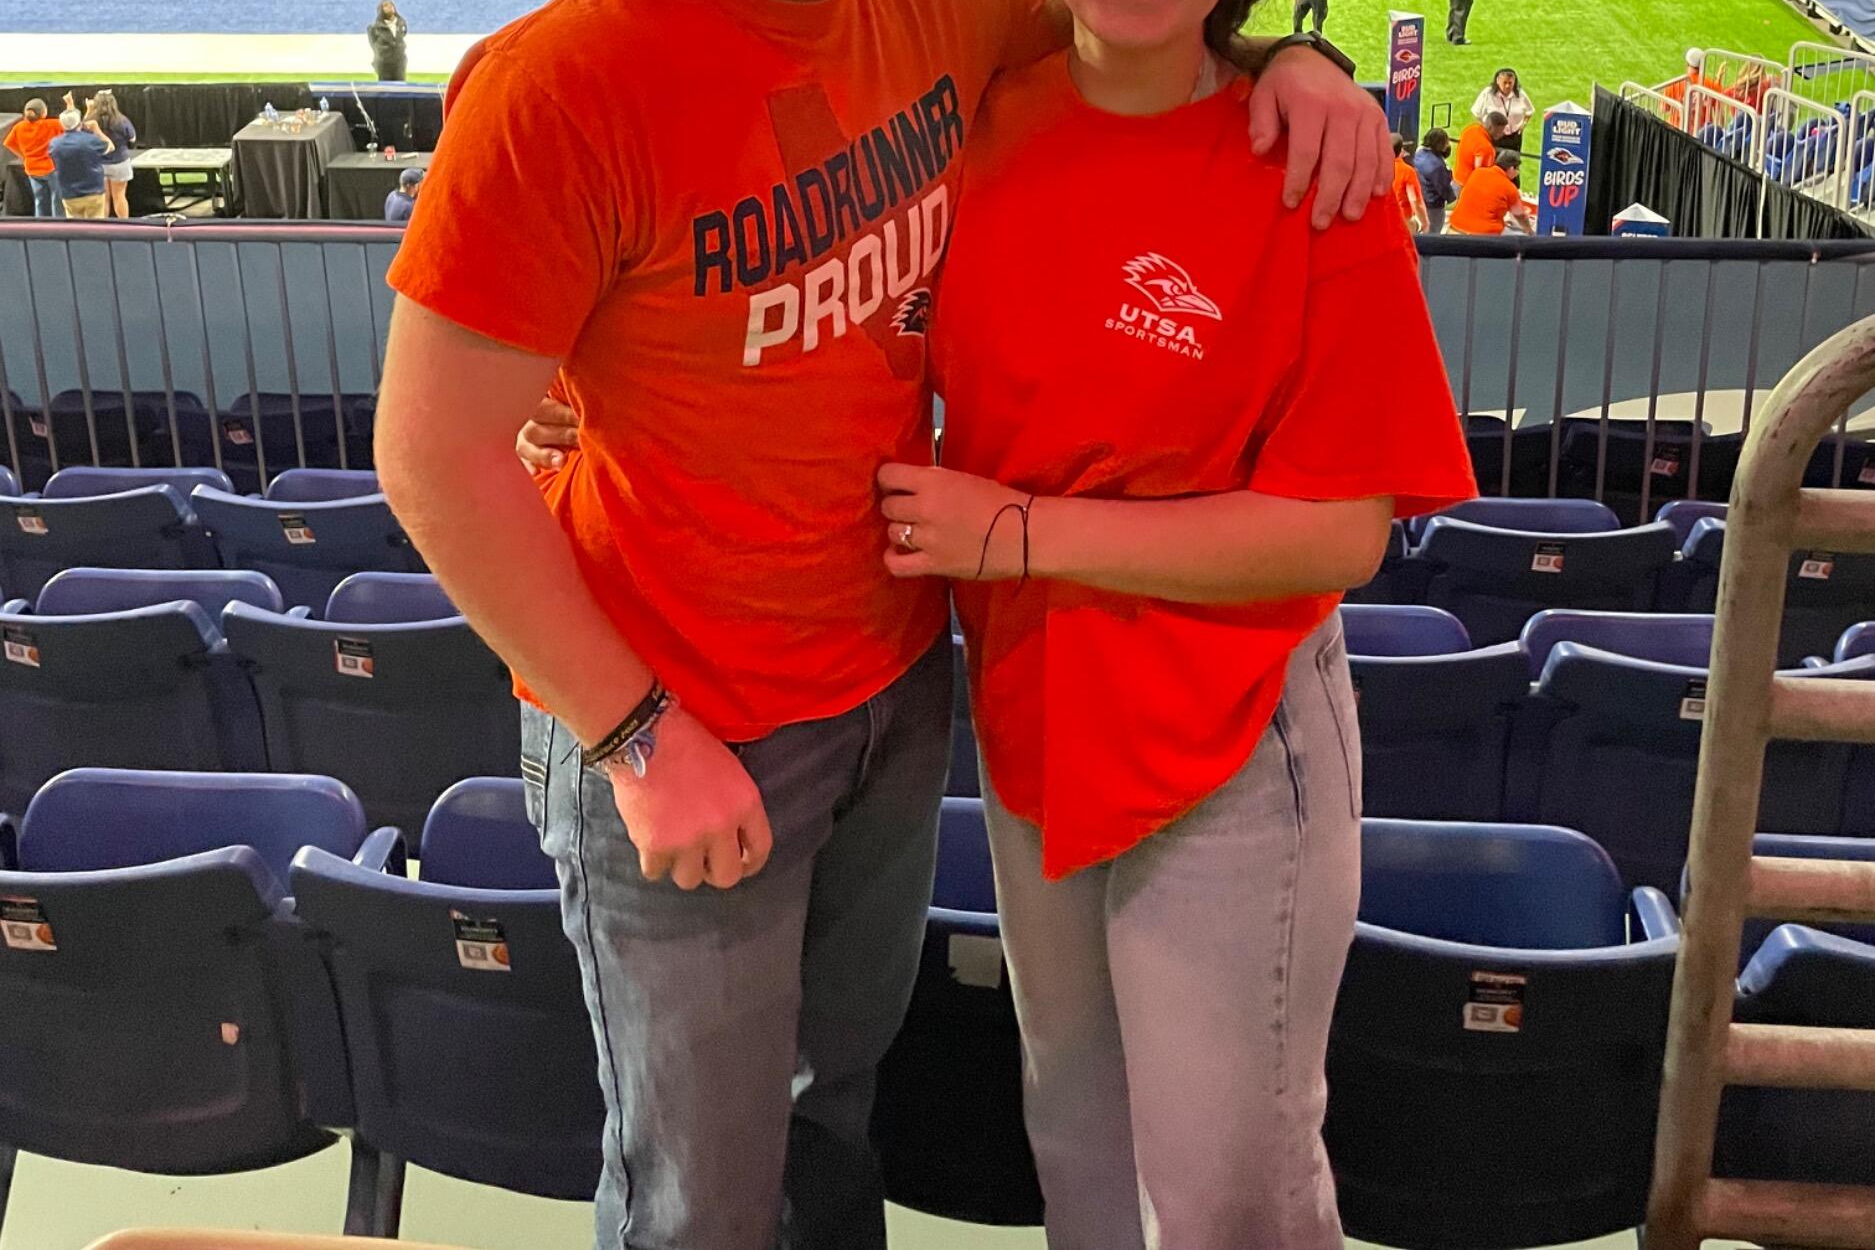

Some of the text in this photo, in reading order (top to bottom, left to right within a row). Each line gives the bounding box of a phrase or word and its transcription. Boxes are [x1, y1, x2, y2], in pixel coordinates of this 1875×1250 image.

[1392, 64, 1421, 84] BIRDS
[1395, 78, 1417, 101] UP
[1552, 126, 1581, 136] LIGHT
[692, 73, 963, 297] ROADRUNNER
[1543, 170, 1585, 186] BIRDS
[1548, 185, 1579, 208] UP
[742, 184, 949, 366] PROUD
[1119, 303, 1197, 346] UTSA
[1104, 318, 1204, 361] SPORTSMAN
